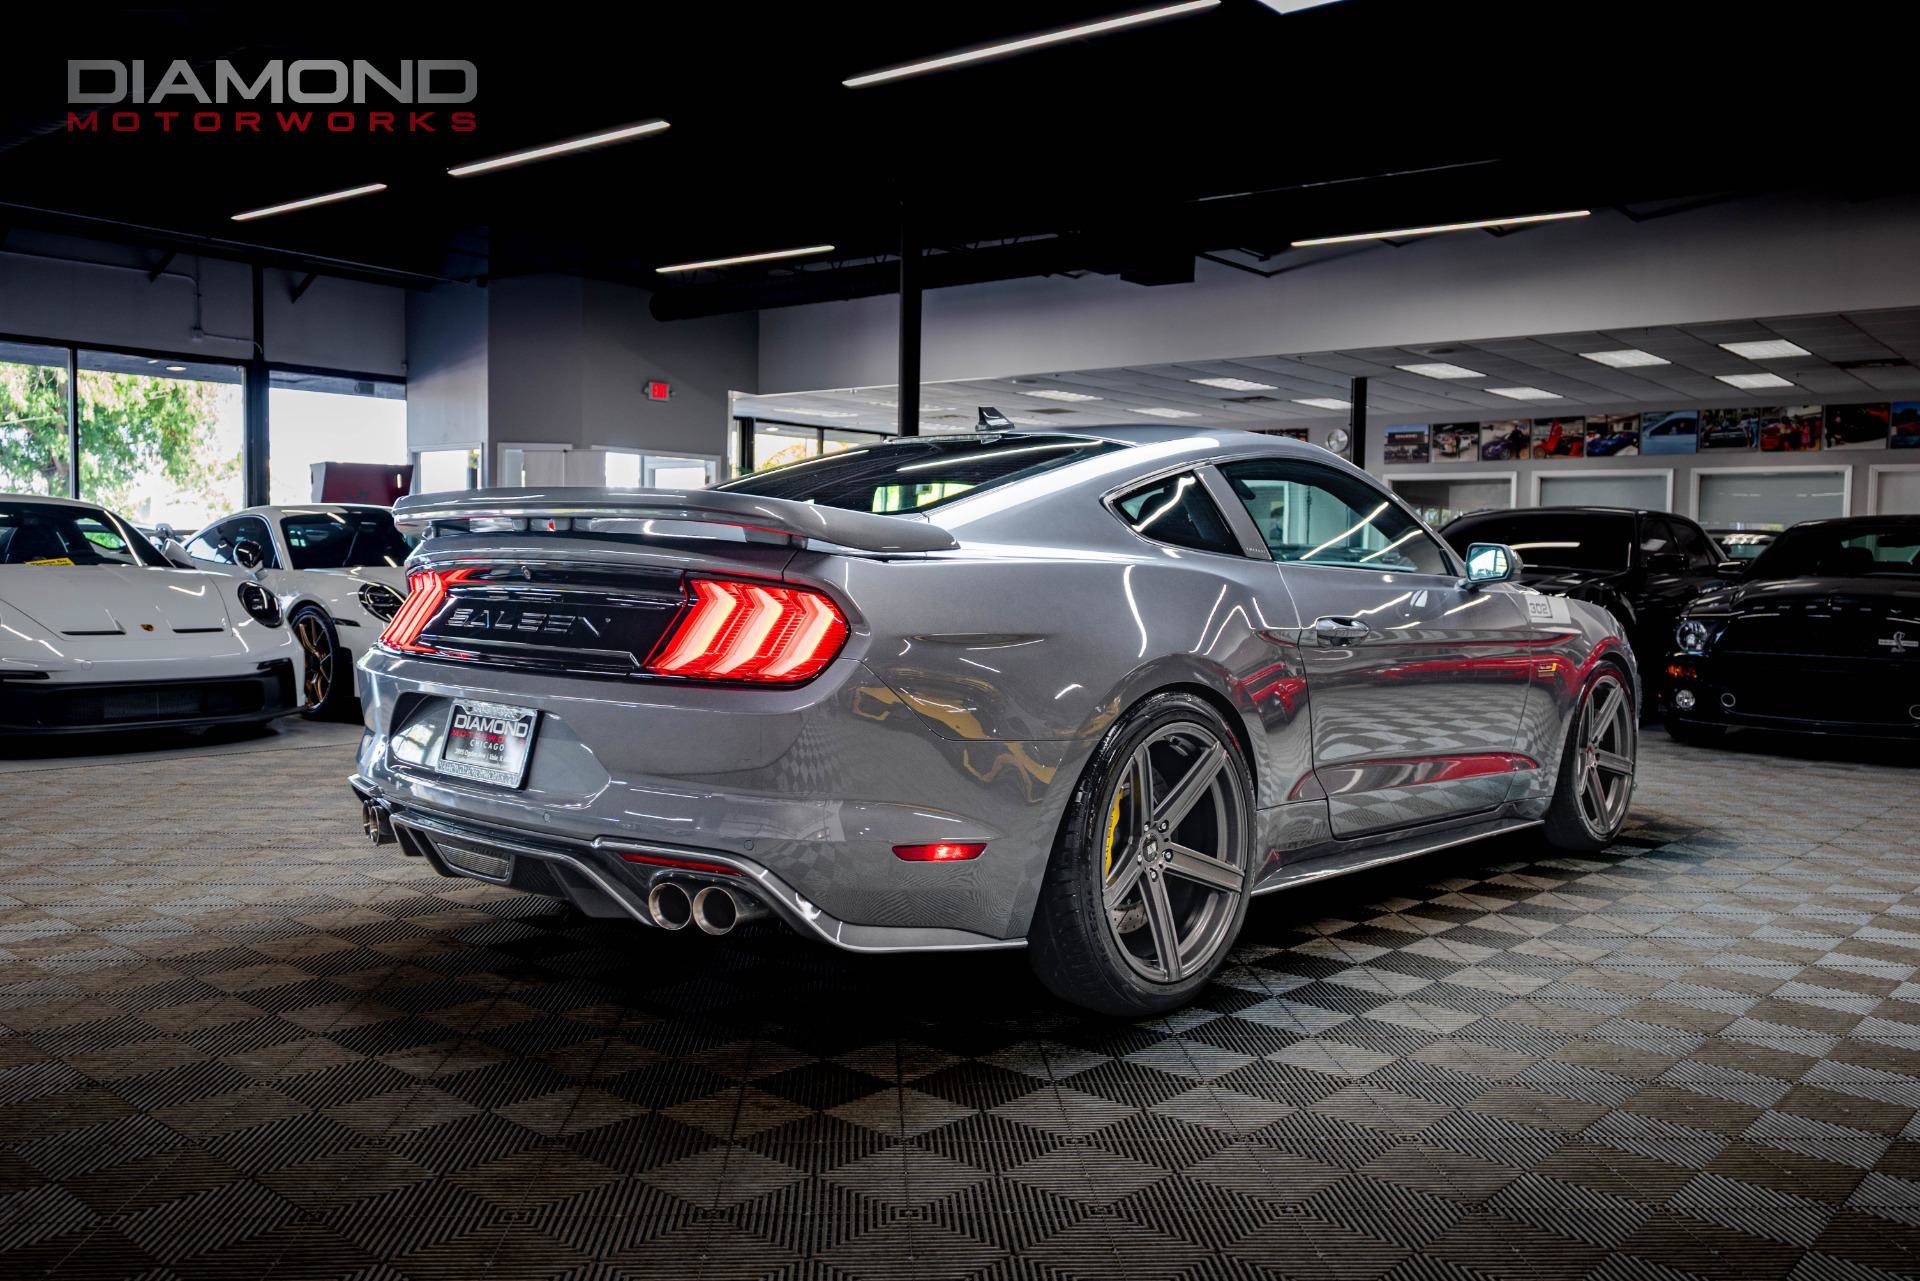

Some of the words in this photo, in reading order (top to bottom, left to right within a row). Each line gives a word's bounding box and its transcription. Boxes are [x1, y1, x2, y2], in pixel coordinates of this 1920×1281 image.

[1529, 602, 1549, 615] 302
[445, 608, 602, 638] SALEEN
[453, 713, 529, 738] DIAMOND
[450, 728, 526, 747] MOTORWOS
[469, 739, 505, 751] CHICAGO
